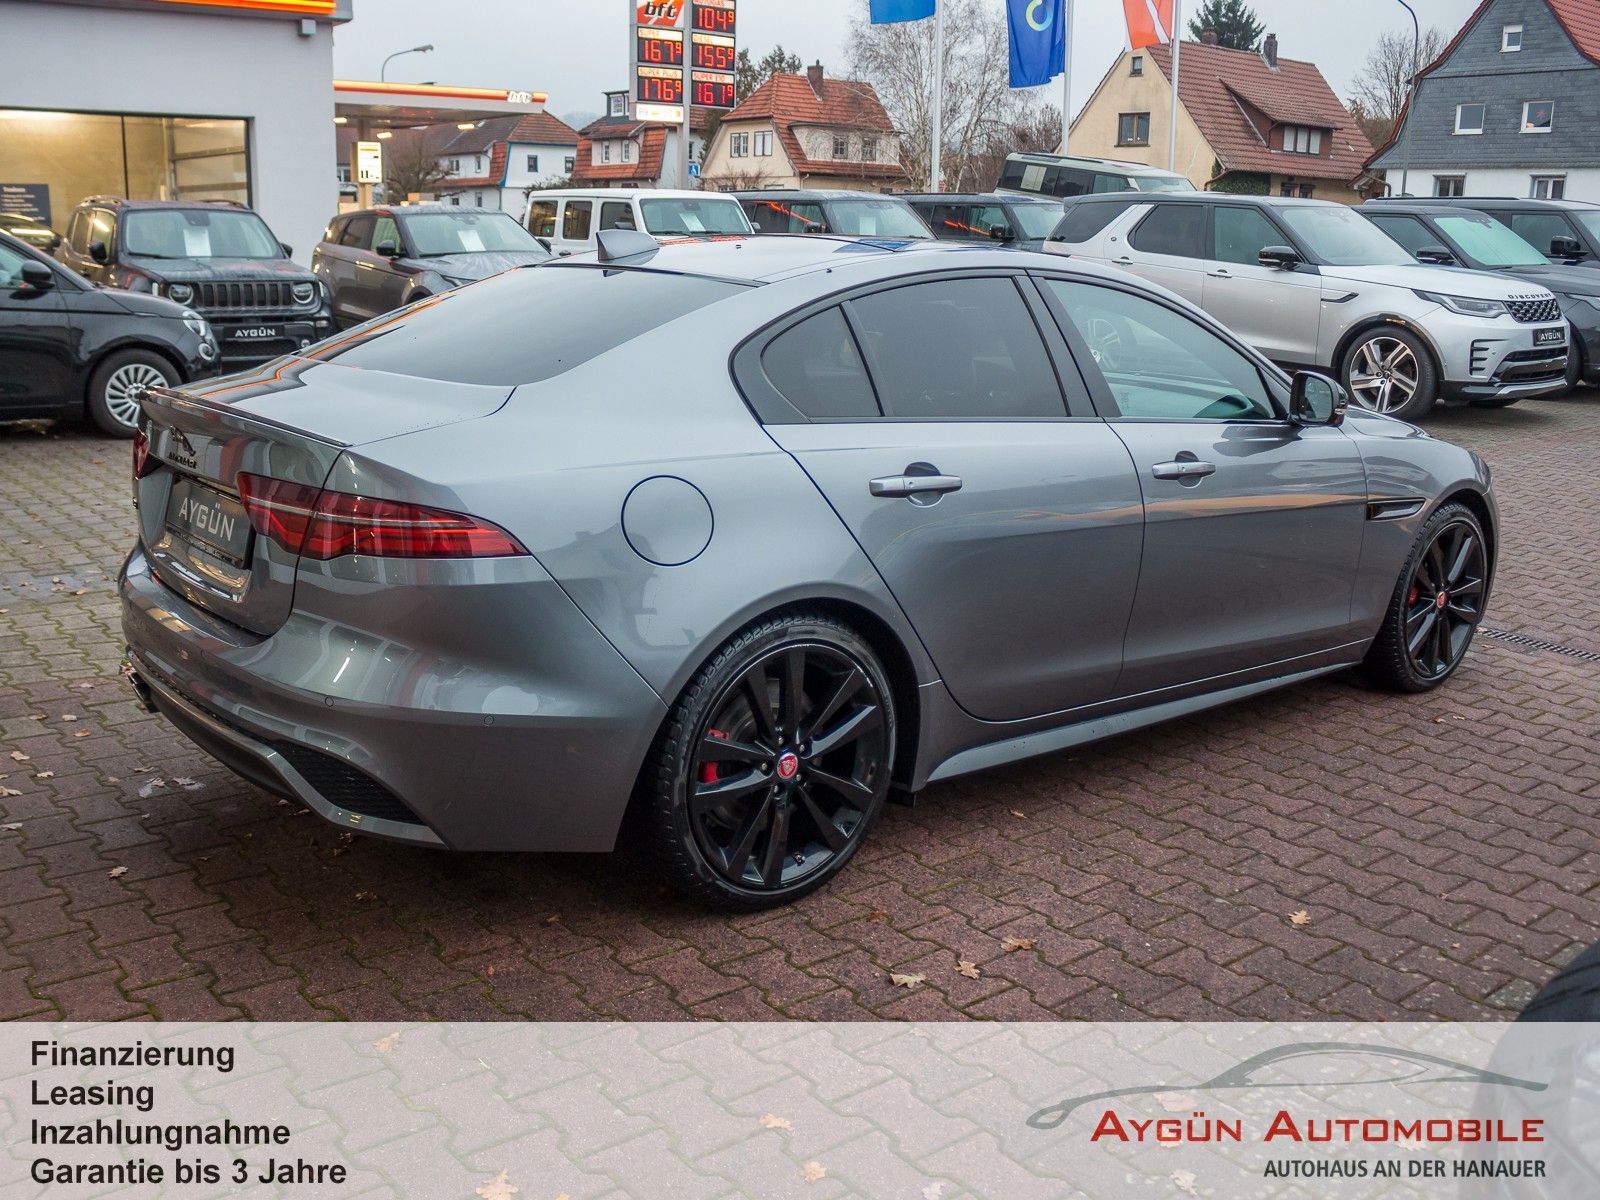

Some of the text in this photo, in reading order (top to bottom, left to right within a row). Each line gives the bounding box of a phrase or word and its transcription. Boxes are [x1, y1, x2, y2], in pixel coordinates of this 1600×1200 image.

[645, 2, 677, 19] bft
[234, 327, 276, 337] AYGÜN
[1540, 330, 1561, 341] AYGÜN
[178, 497, 235, 542] AYGÜN
